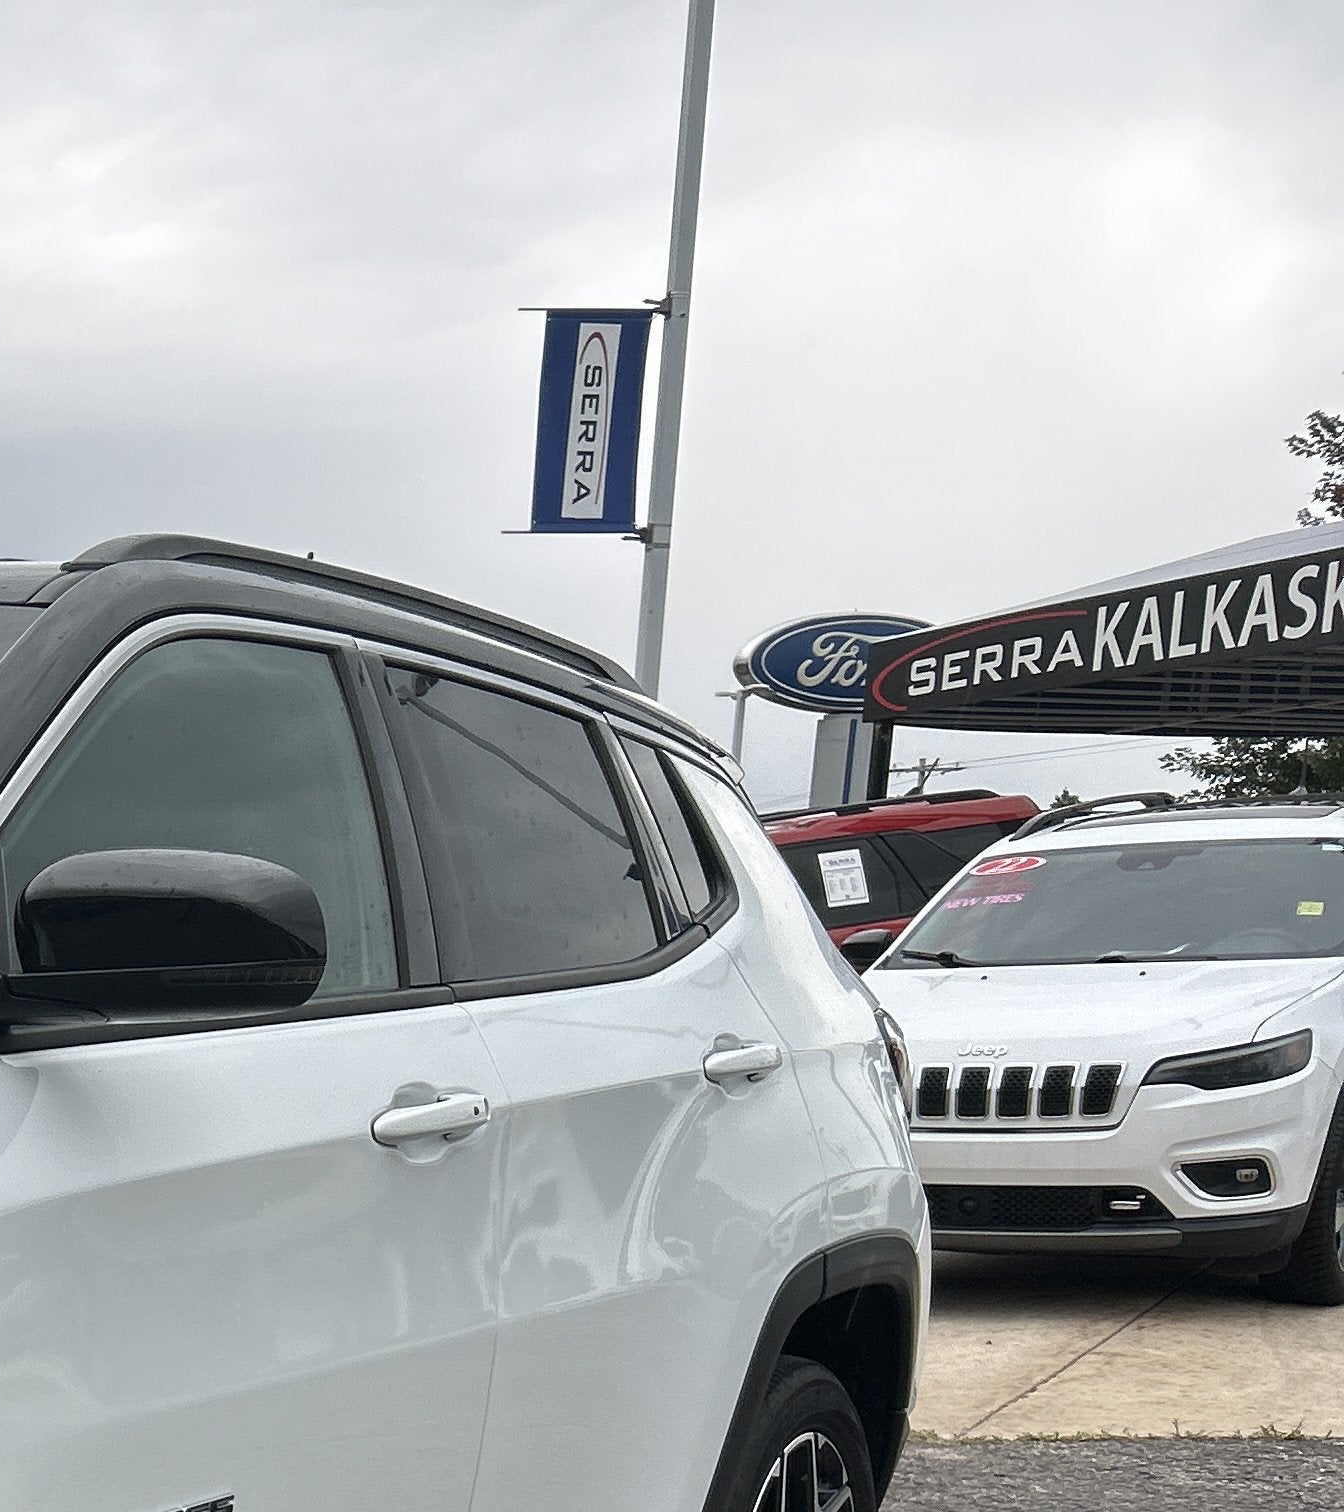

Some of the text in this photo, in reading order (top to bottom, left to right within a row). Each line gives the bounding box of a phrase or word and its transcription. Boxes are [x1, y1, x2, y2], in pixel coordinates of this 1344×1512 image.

[572, 364, 603, 505] SERRA
[907, 630, 1084, 696] SERRA
[983, 893, 1025, 905] TIRES
[957, 1041, 1009, 1059] Jeep
